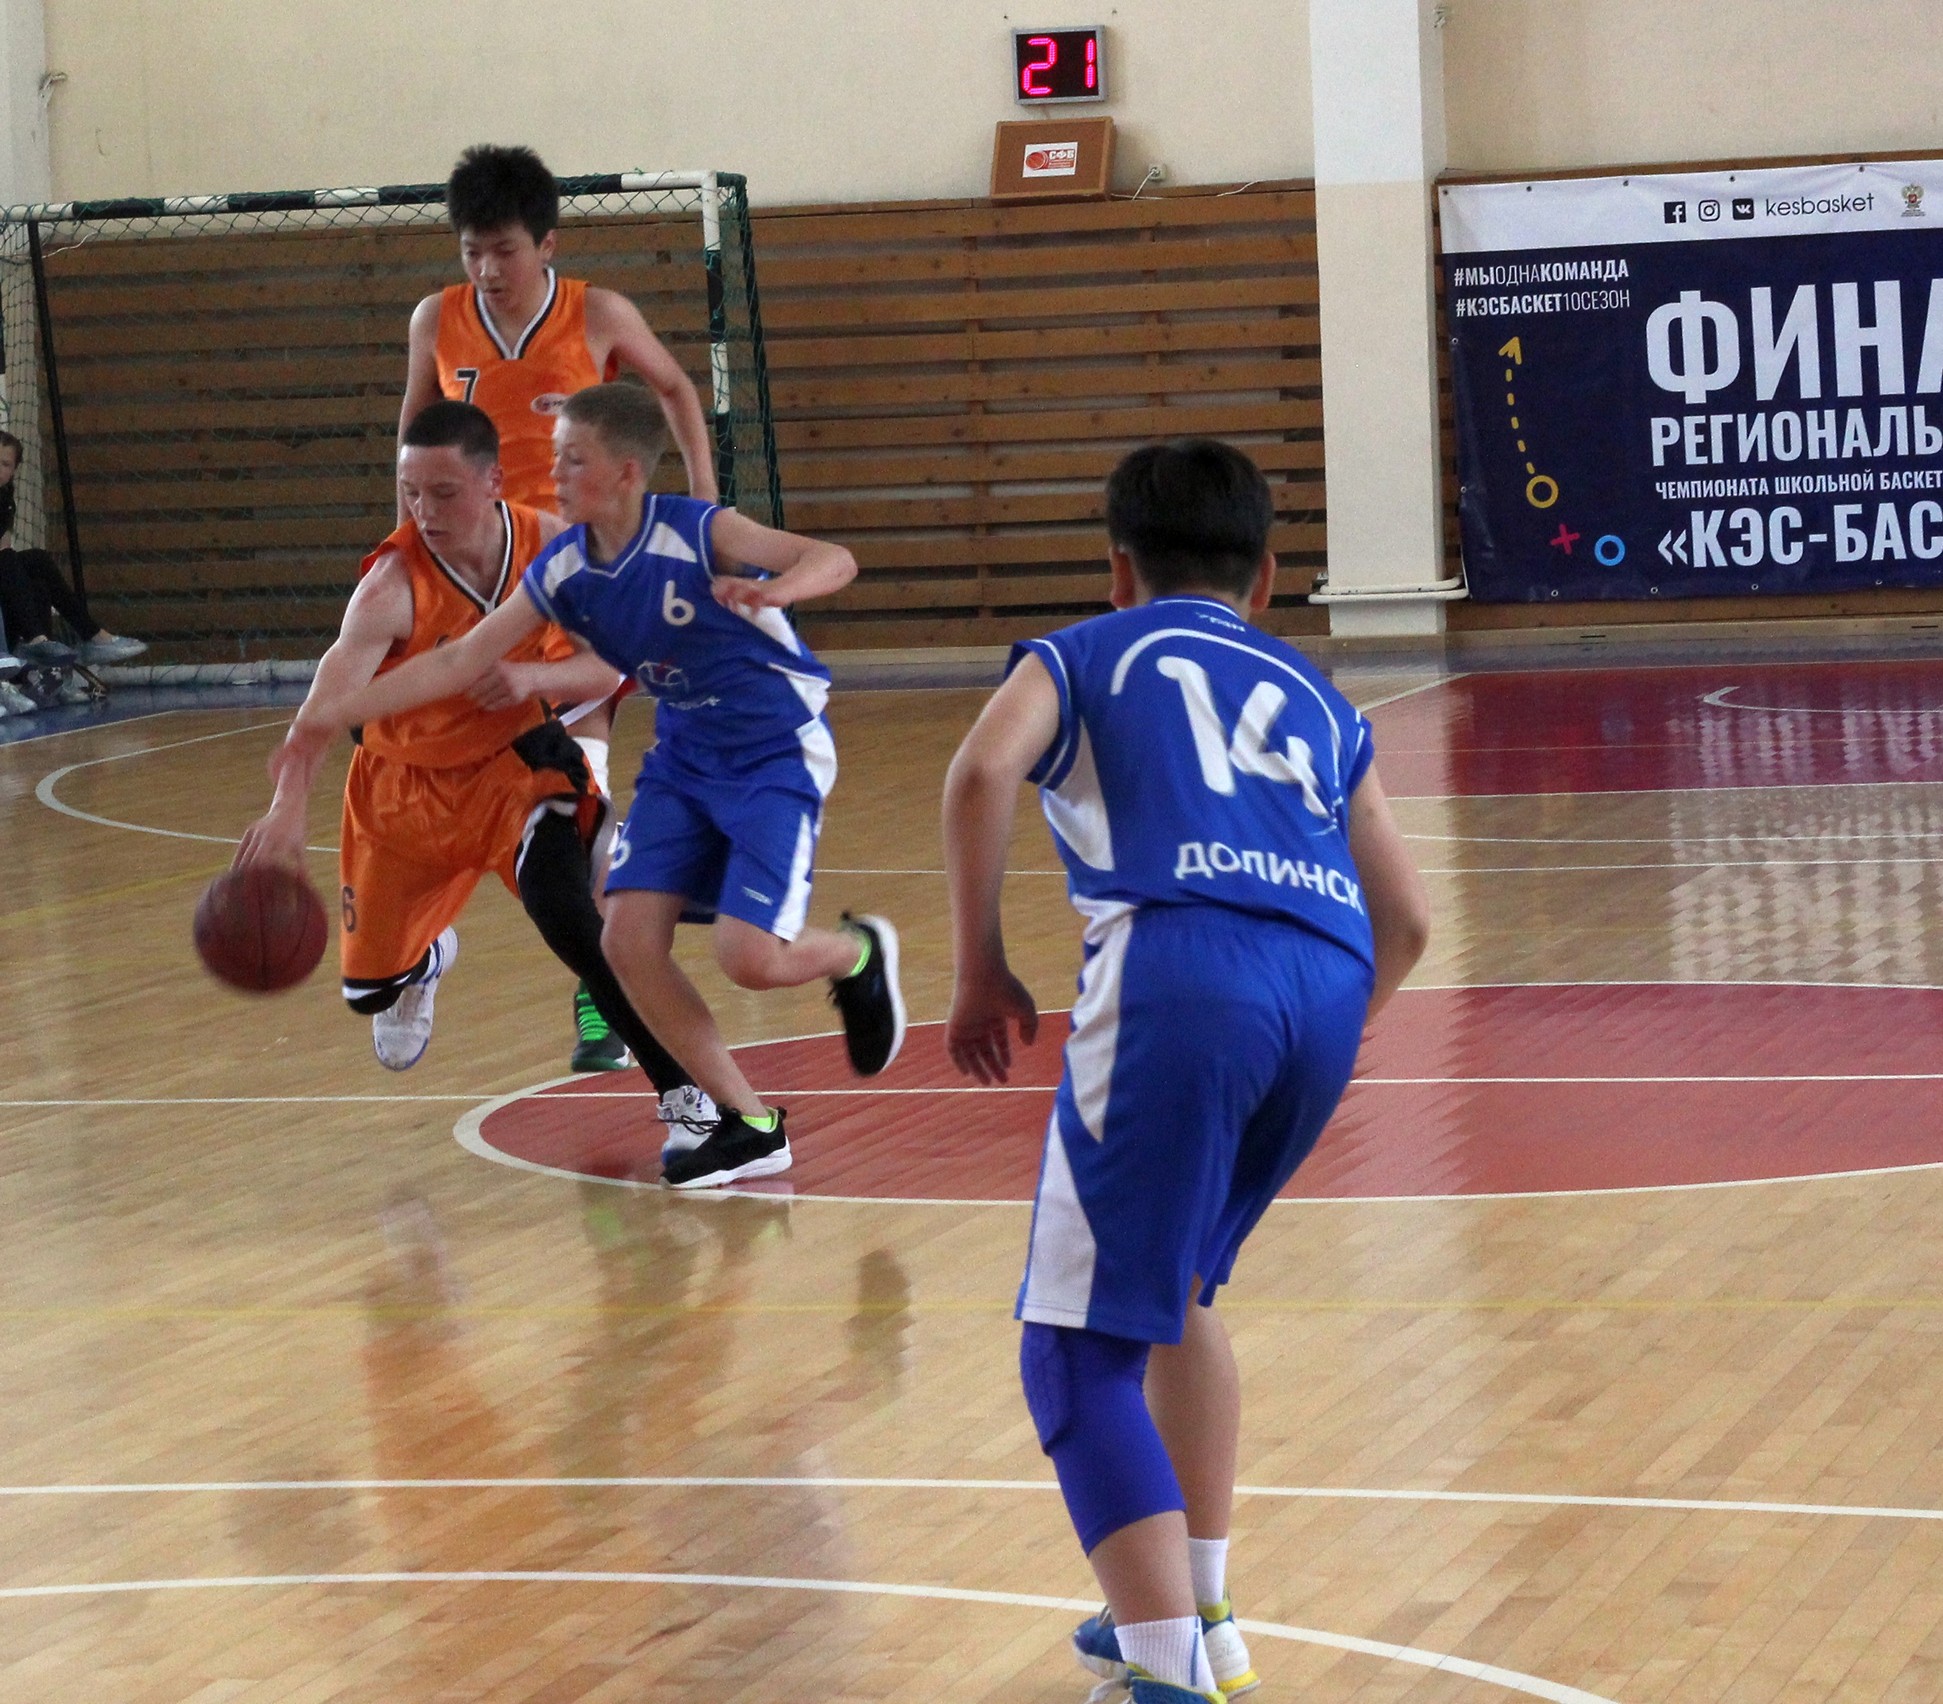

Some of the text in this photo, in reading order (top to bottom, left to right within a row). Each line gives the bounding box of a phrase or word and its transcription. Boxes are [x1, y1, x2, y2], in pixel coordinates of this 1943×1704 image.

[1021, 37, 1096, 96] 21
[1765, 192, 1875, 217] kesbasket
[1454, 258, 1630, 287] #МЫОДНАКОМАНДА
[1456, 289, 1631, 317] #КЭСБАСКЕТ10СЕЗОН
[455, 367, 480, 404] 7
[1651, 405, 1943, 467] РЕГИОНАЛЬ
[1655, 477, 1770, 500] ЧЕМПИОНАТА
[1774, 469, 1875, 496] ШКОЛЬНОЙ
[662, 580, 695, 626] 6
[1156, 655, 1330, 818] 14
[342, 885, 356, 933] 6
